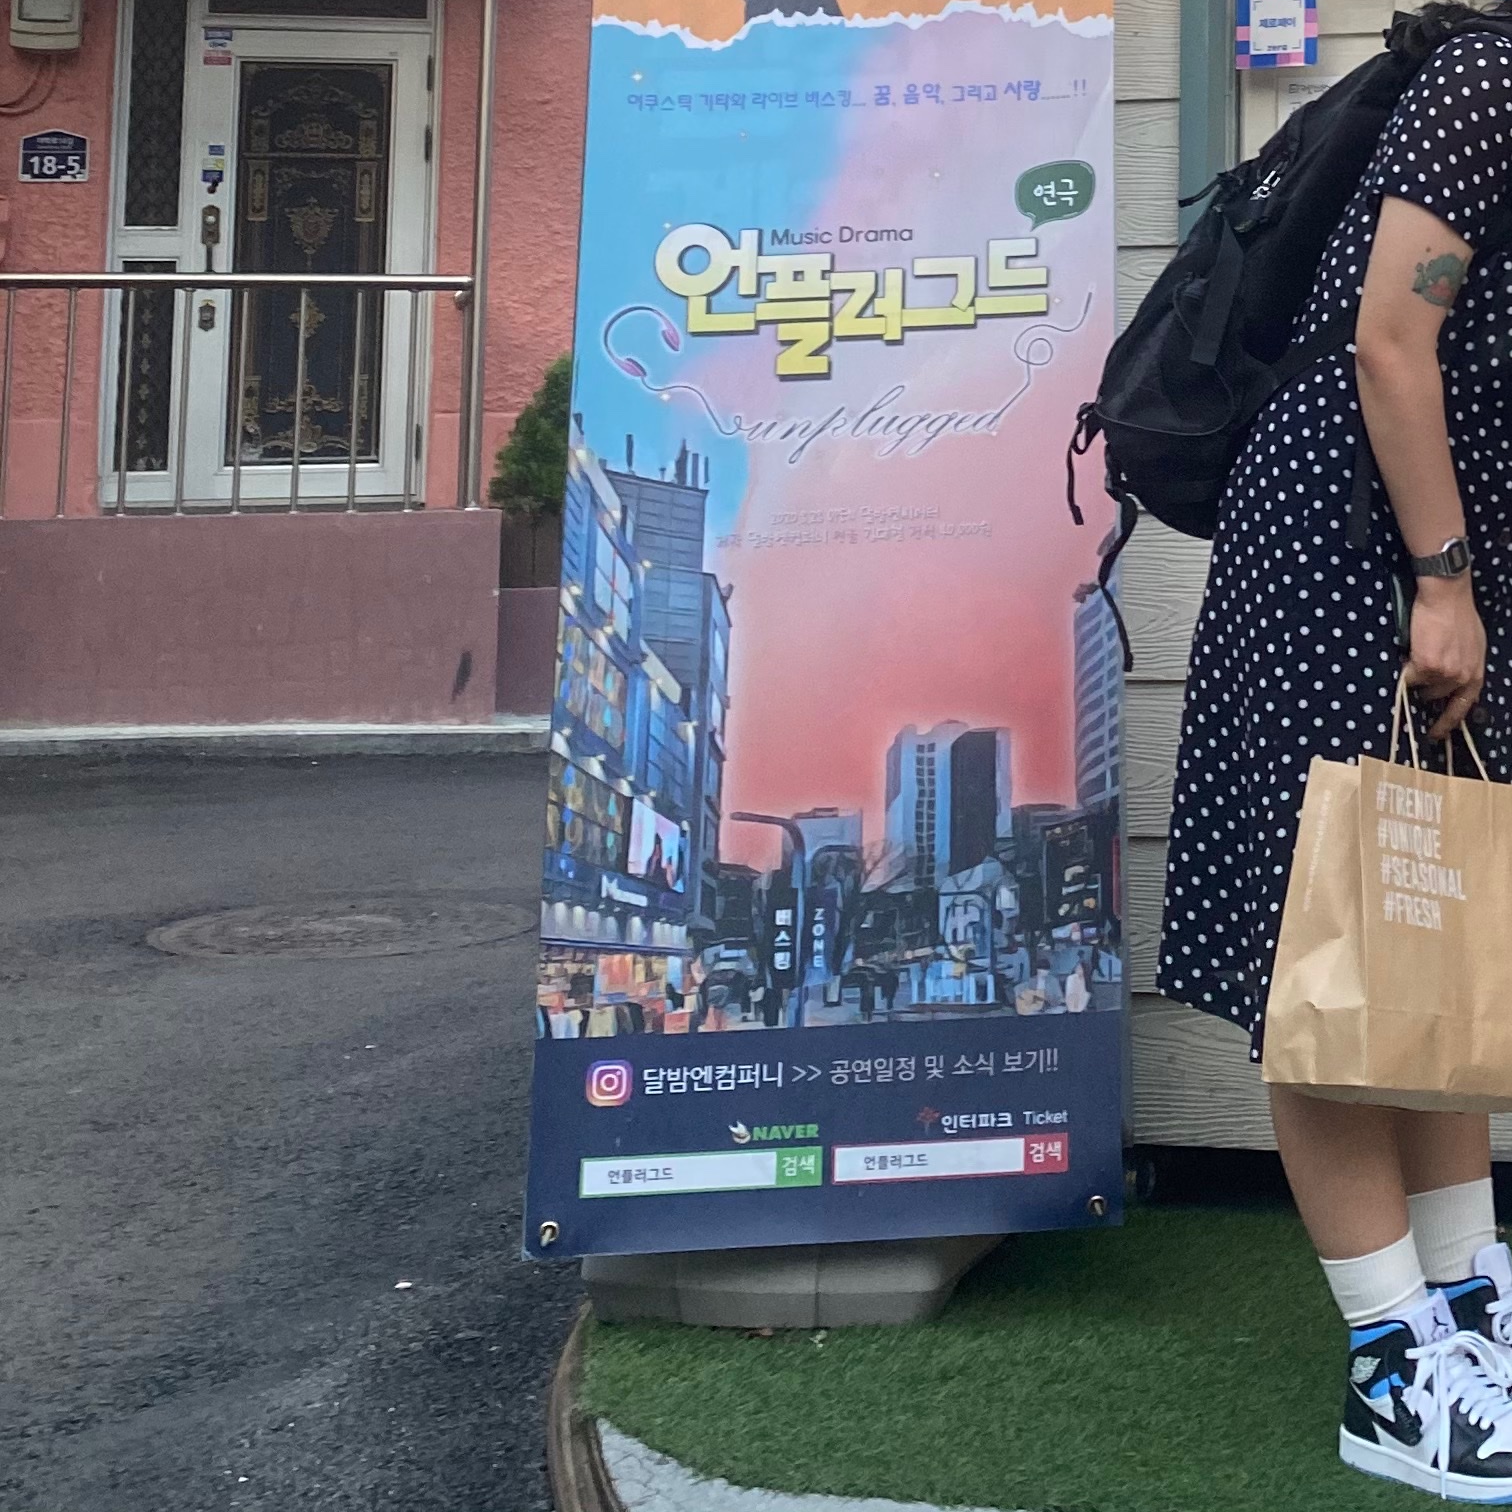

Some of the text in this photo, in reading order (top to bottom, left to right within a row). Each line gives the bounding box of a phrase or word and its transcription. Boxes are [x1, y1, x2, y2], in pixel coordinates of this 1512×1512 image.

[626, 92, 693, 112] 어쿠스틱
[699, 91, 746, 111] 기타와
[751, 91, 799, 109] 라이브
[951, 84, 998, 103] 그리고
[29, 155, 81, 175] 18-5
[1033, 177, 1080, 207] 연극
[770, 225, 914, 246] Music Drama
[654, 222, 1050, 381] 언플러그드
[735, 384, 1000, 465] unplugged
[1375, 780, 1443, 824] #TRENDY
[1376, 817, 1443, 861] #UNIQUE
[1379, 853, 1468, 901] #SEASONAL
[1382, 890, 1443, 931] #FRESH
[812, 907, 826, 968] ZONE
[642, 1061, 784, 1095] 달밤엔컴퍼니
[829, 1056, 917, 1085] 공연일정
[924, 1054, 945, 1081] 및
[952, 1051, 995, 1077] 소식
[1001, 1047, 1059, 1074] 보기!!
[751, 1123, 819, 1142] NAVER
[940, 1109, 1069, 1134] 인터파크 Ticket
[607, 1154, 816, 1185] 언플러그드 검색
[863, 1140, 1063, 1172] 언플러그드 검색
